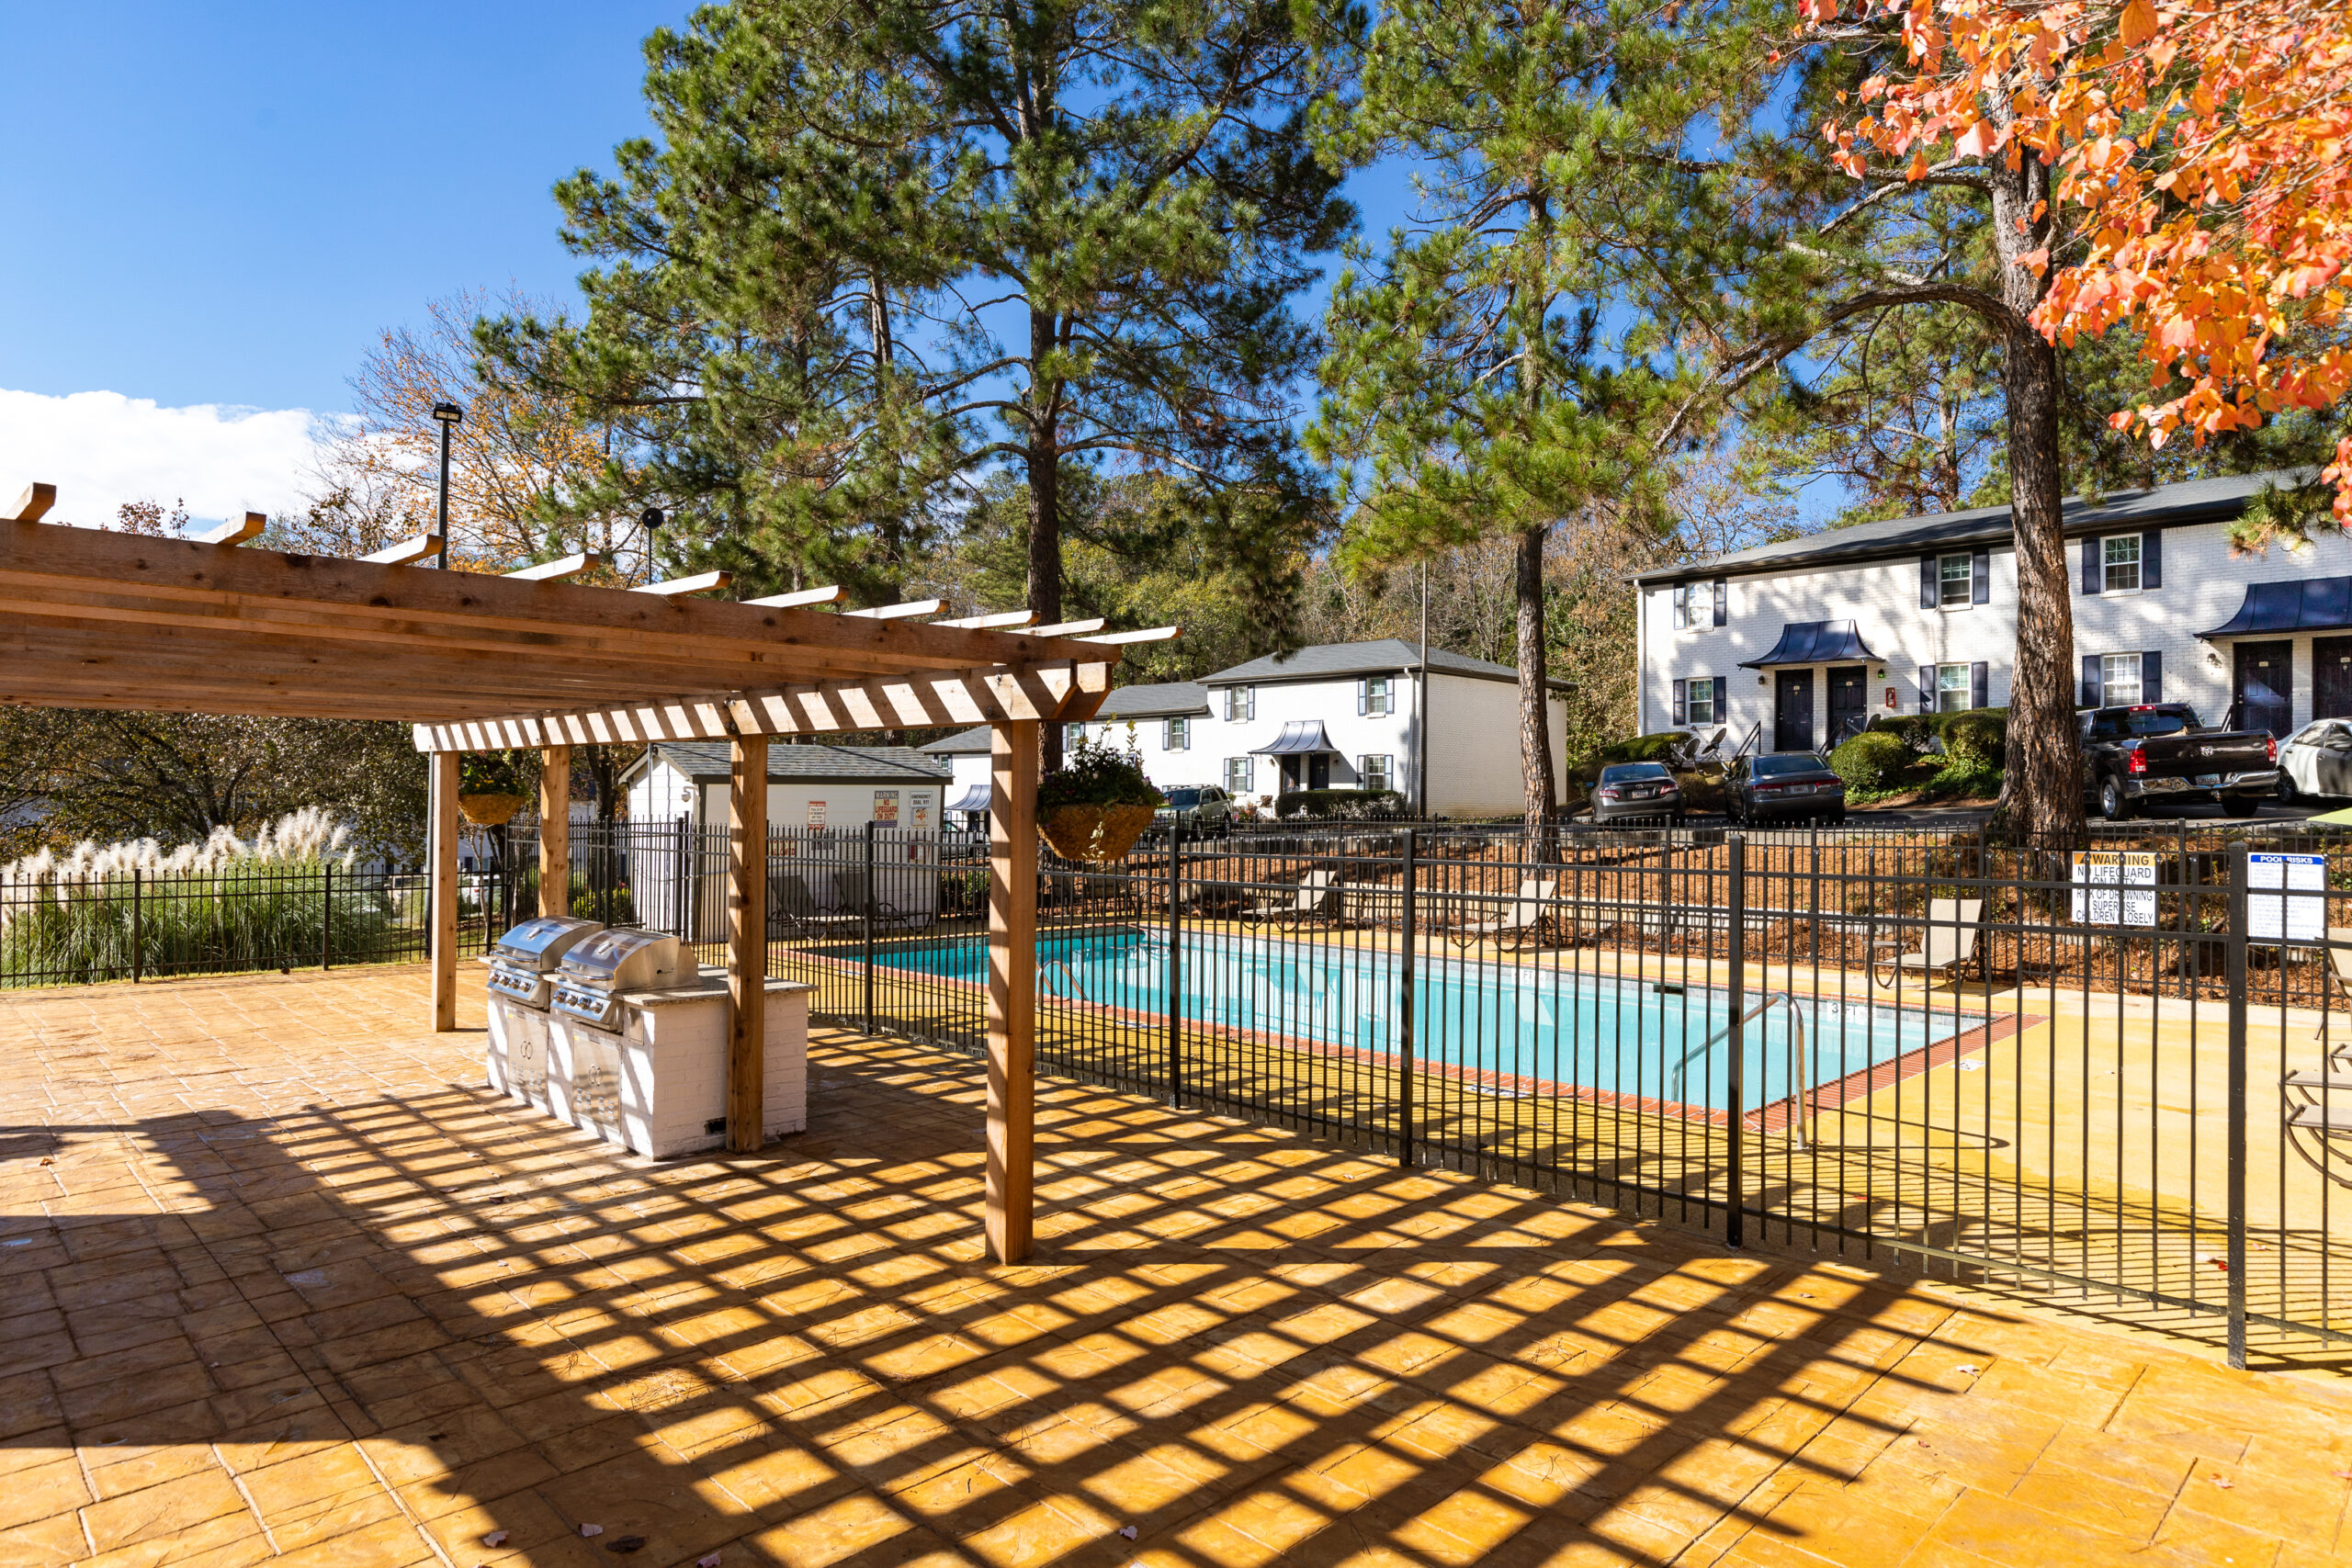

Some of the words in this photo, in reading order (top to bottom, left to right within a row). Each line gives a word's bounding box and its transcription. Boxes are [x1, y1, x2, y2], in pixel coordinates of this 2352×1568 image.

[876, 791, 899, 799] WARNING
[2078, 866, 2091, 876] N
[2077, 889, 2094, 898] RIK
[2097, 889, 2107, 899] OF
[2093, 900, 2136, 912] SUPERISE
[2119, 912, 2154, 924] LOSELY
[1832, 1003, 1838, 1013] 3
